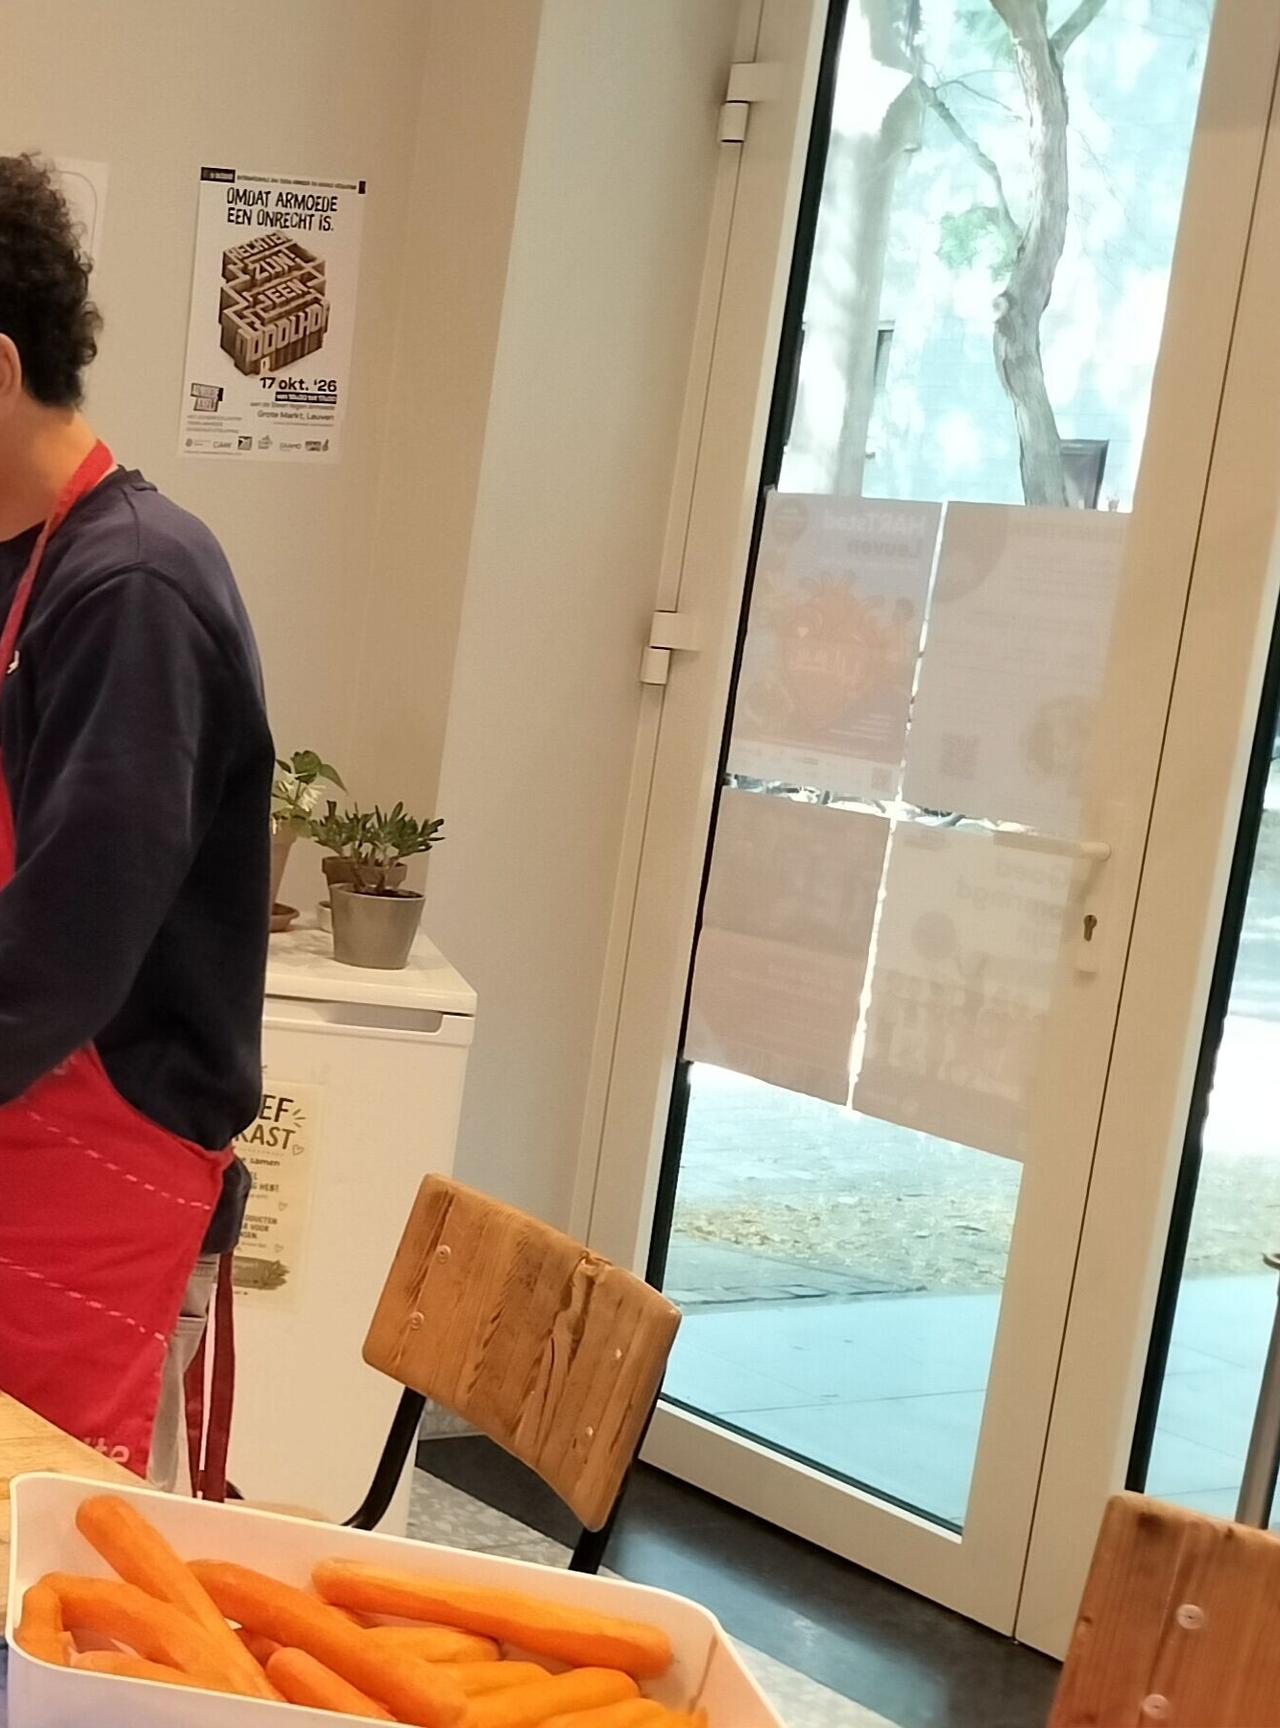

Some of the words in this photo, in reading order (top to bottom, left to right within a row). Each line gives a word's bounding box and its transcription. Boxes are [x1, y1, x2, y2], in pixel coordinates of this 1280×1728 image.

[226, 186, 271, 208] OMDAT
[275, 191, 338, 213] ARMOEDE
[227, 206, 253, 226] EEN
[257, 209, 315, 231] ONRECHT
[259, 377, 276, 389] 17
[278, 377, 309, 391] okt.
[258, 1094, 294, 1122] EF
